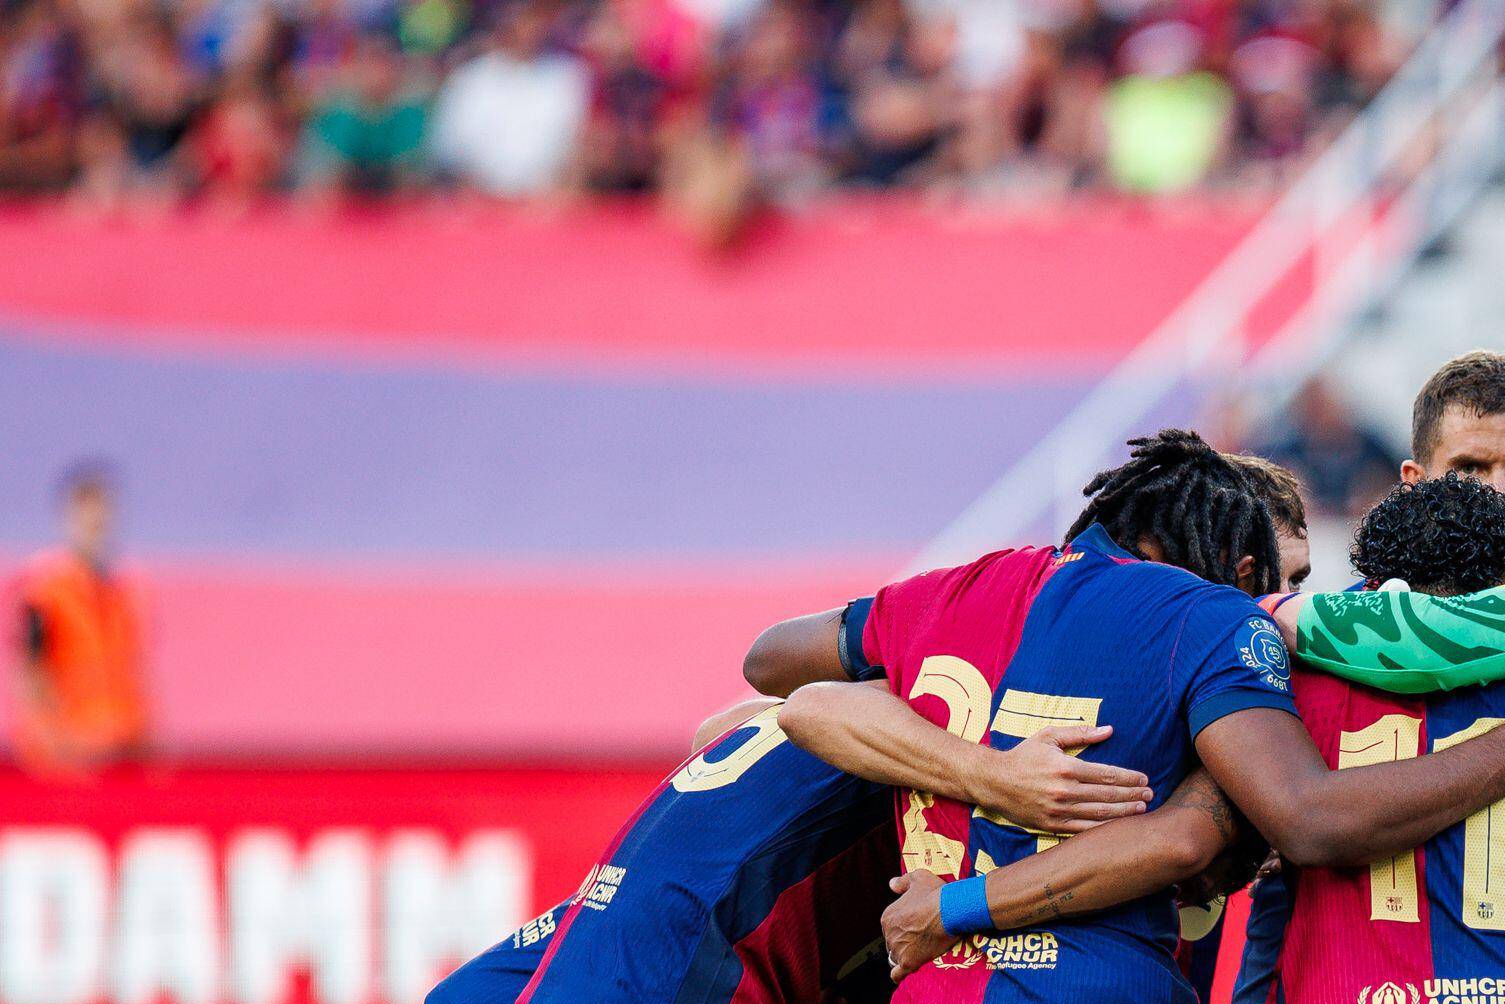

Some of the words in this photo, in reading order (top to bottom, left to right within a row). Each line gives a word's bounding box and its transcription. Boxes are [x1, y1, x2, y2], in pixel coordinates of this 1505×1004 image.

[973, 932, 1058, 952] UNHCR
[986, 948, 1058, 963] CNUR
[1027, 962, 1057, 970] Agency
